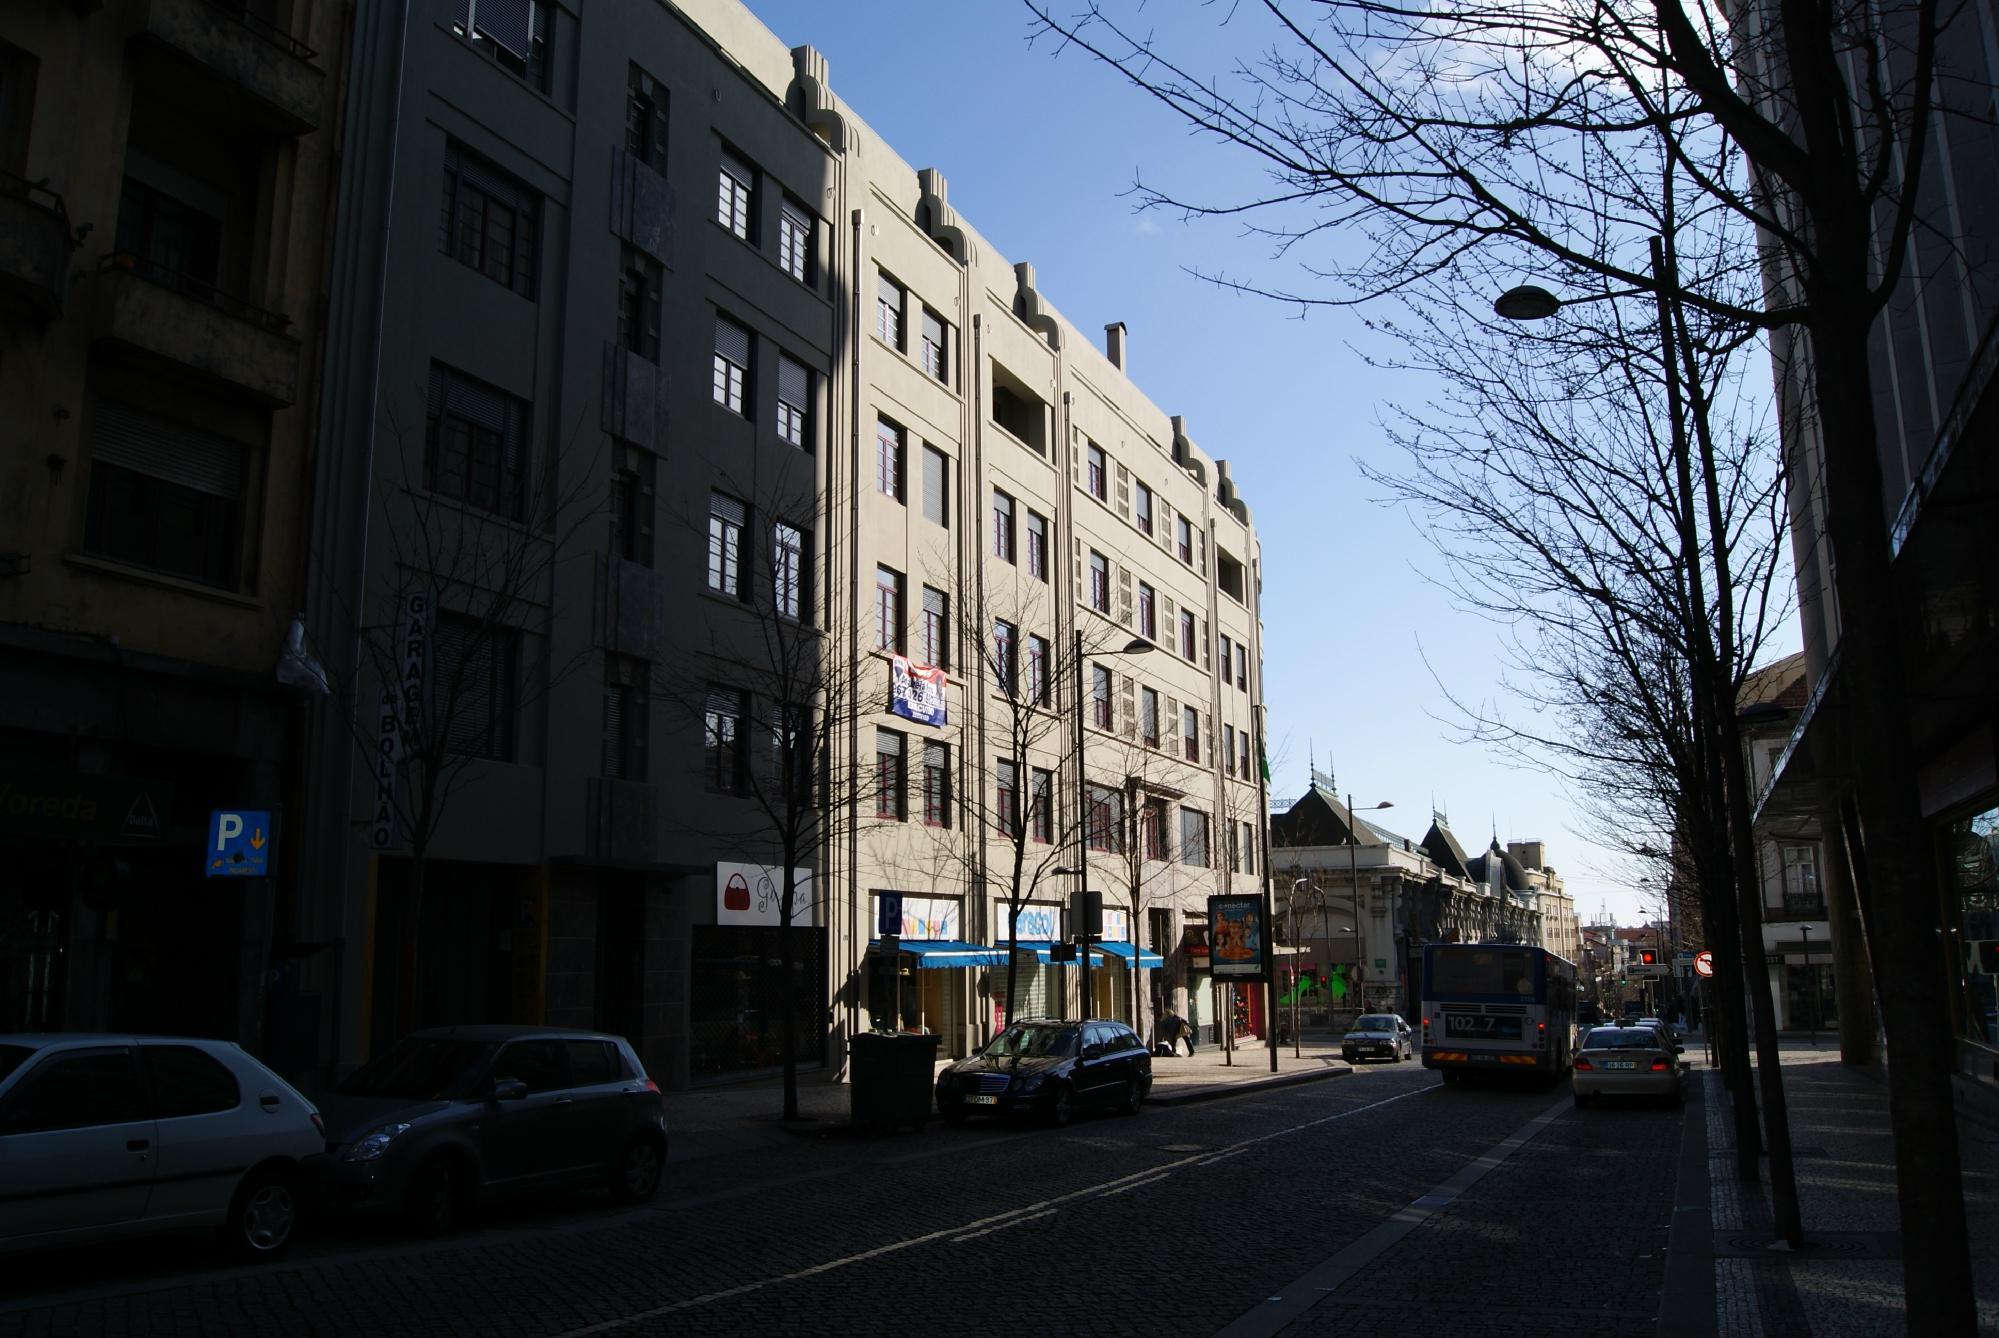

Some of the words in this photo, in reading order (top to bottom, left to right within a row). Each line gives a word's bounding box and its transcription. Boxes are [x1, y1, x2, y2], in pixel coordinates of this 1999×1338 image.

[374, 715, 396, 846] BOLHÃO
[216, 813, 244, 851] P
[885, 896, 898, 930] P
